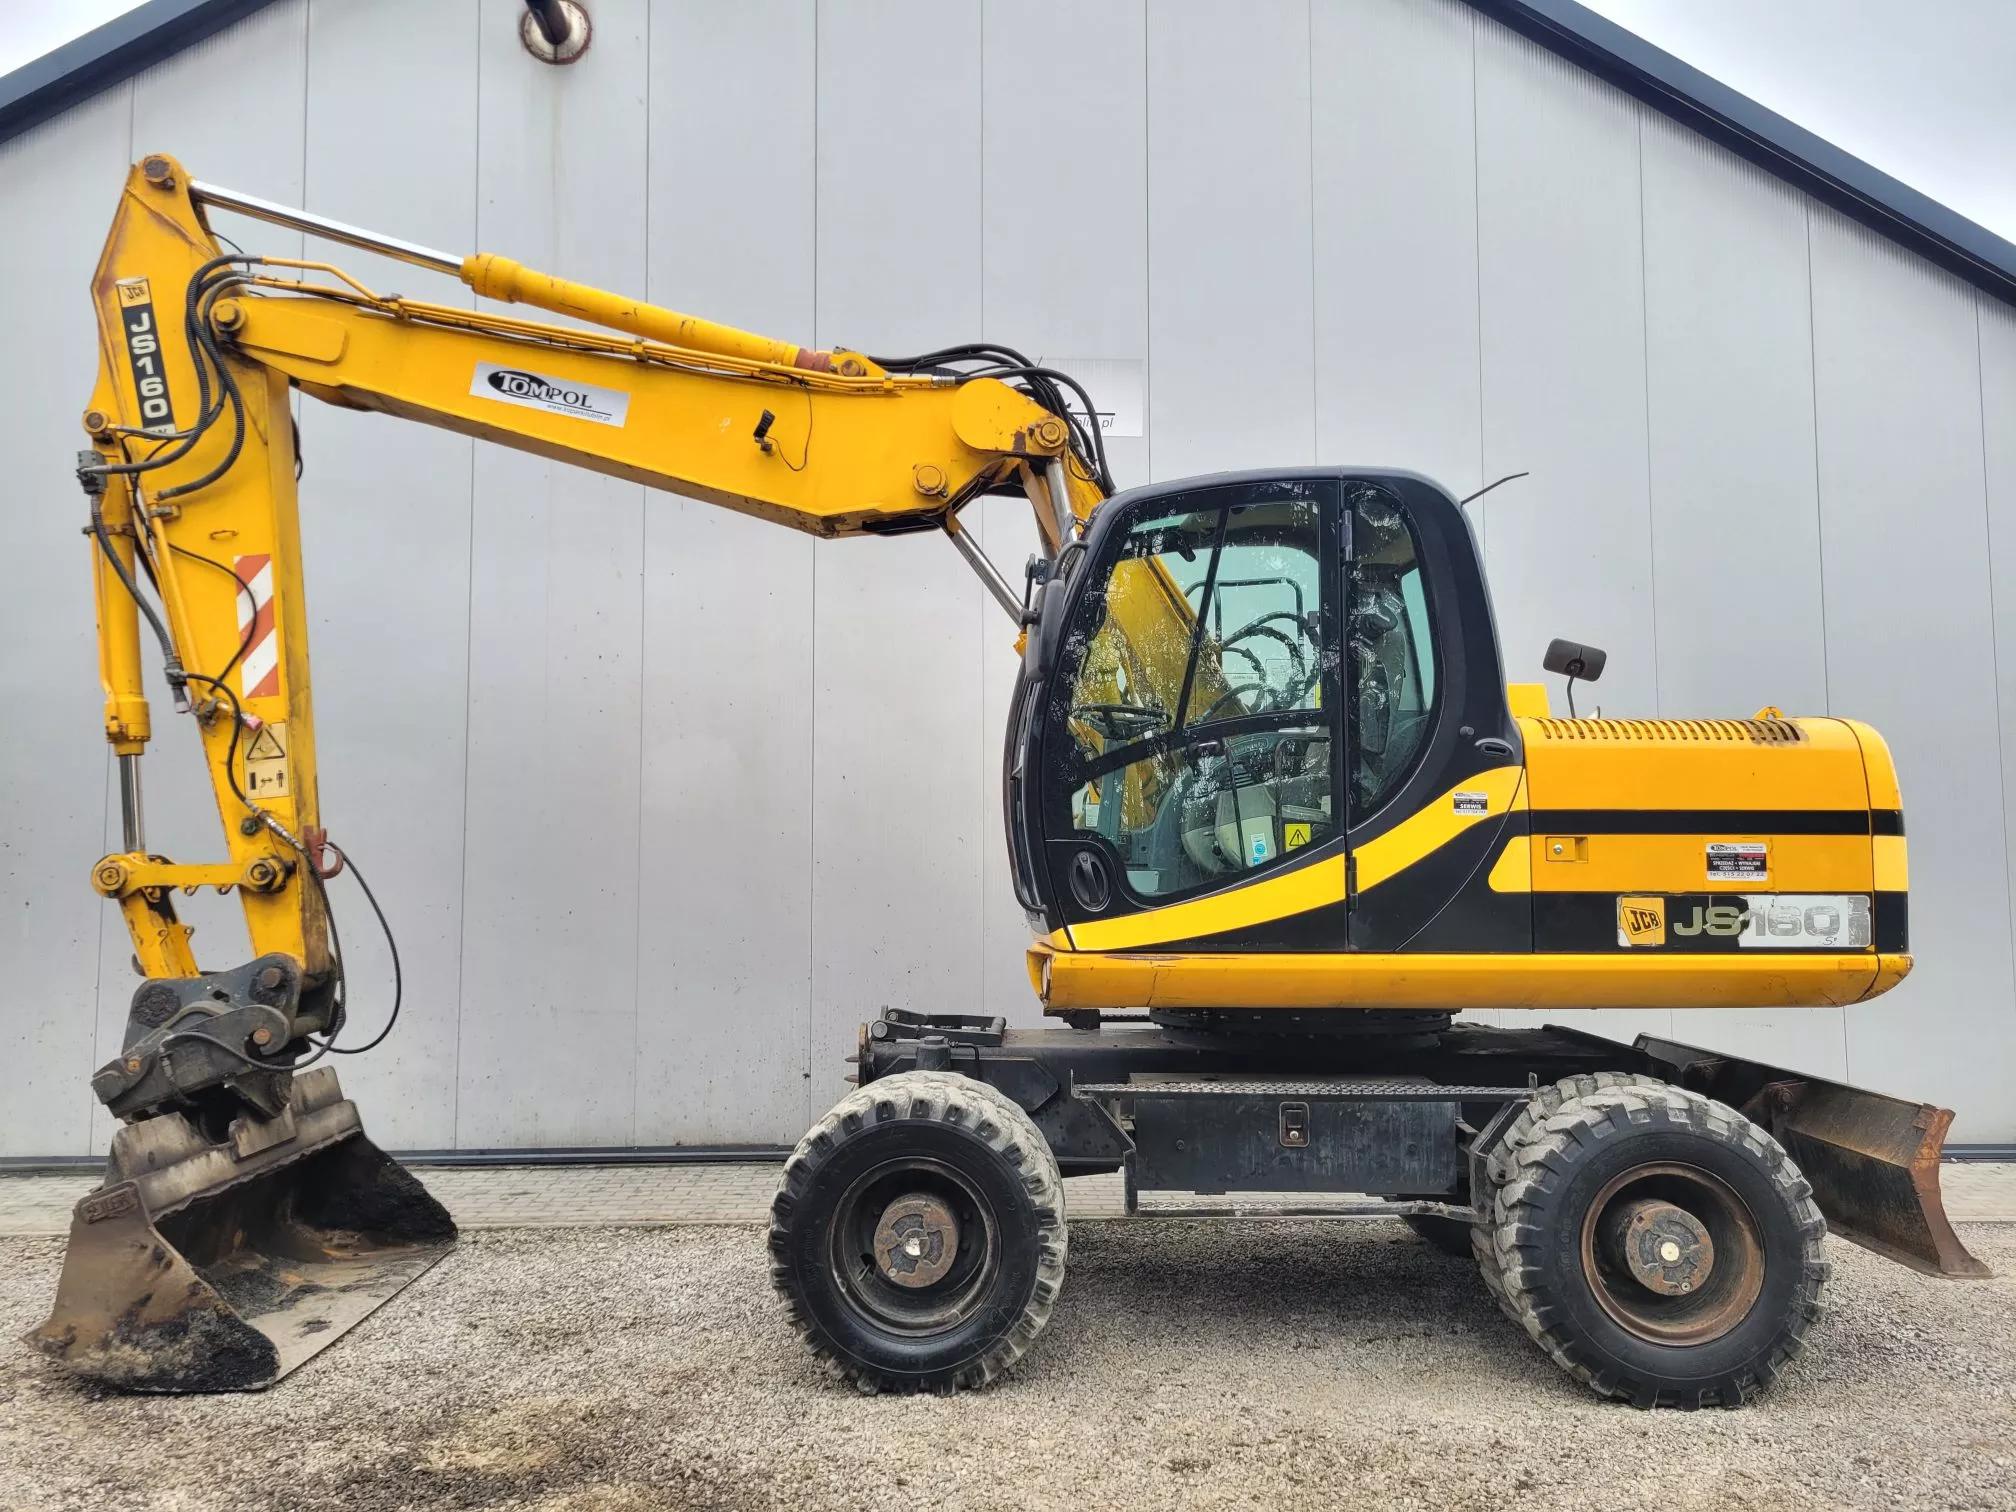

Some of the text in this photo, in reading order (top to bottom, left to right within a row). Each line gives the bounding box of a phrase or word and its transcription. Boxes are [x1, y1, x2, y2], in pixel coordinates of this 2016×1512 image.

[126, 286, 146, 301] JCB
[129, 311, 169, 419] JS160
[497, 371, 593, 409] TOMPOL
[1629, 909, 1660, 933] JCB
[1673, 905, 1841, 938] JS160
